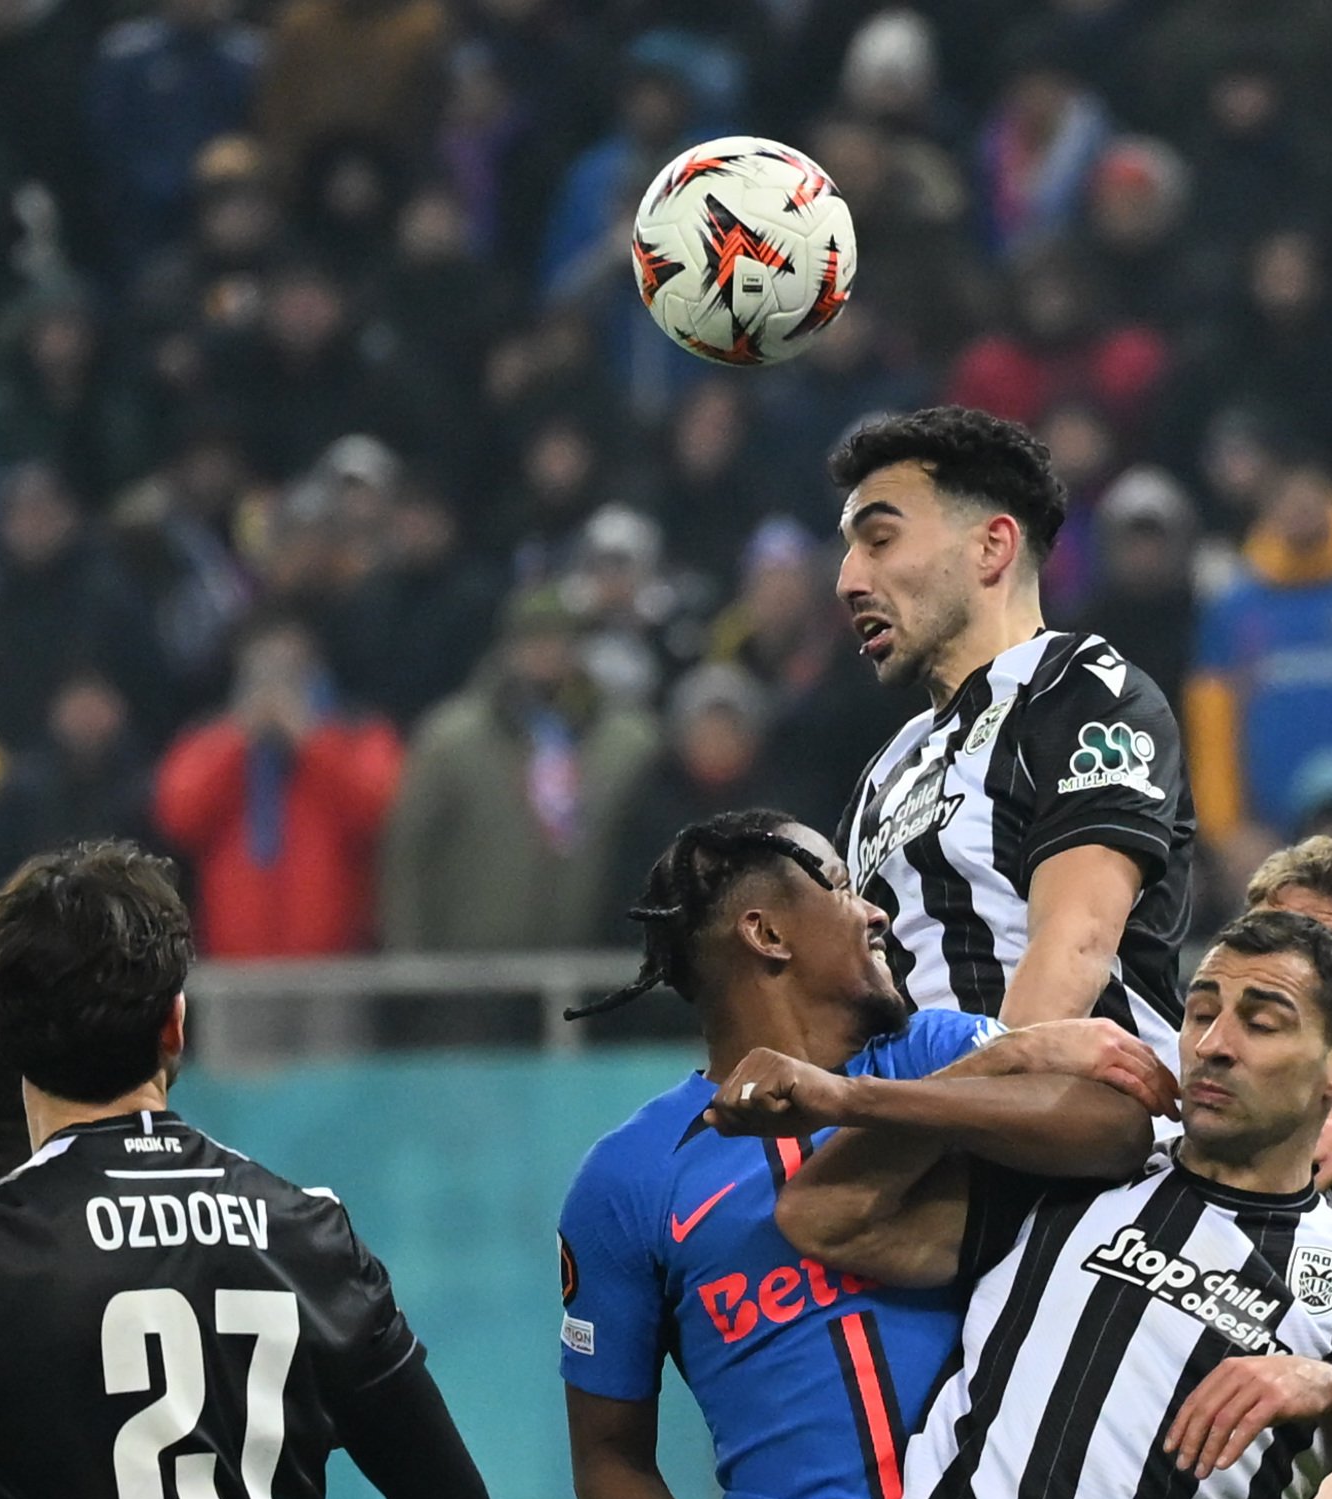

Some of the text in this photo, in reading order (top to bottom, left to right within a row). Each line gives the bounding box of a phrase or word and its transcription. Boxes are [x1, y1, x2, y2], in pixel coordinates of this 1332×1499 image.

[888, 797, 962, 850] obesity
[896, 775, 943, 823] child
[85, 1191, 269, 1251] OZDOEV
[1096, 1227, 1281, 1323] Stop child
